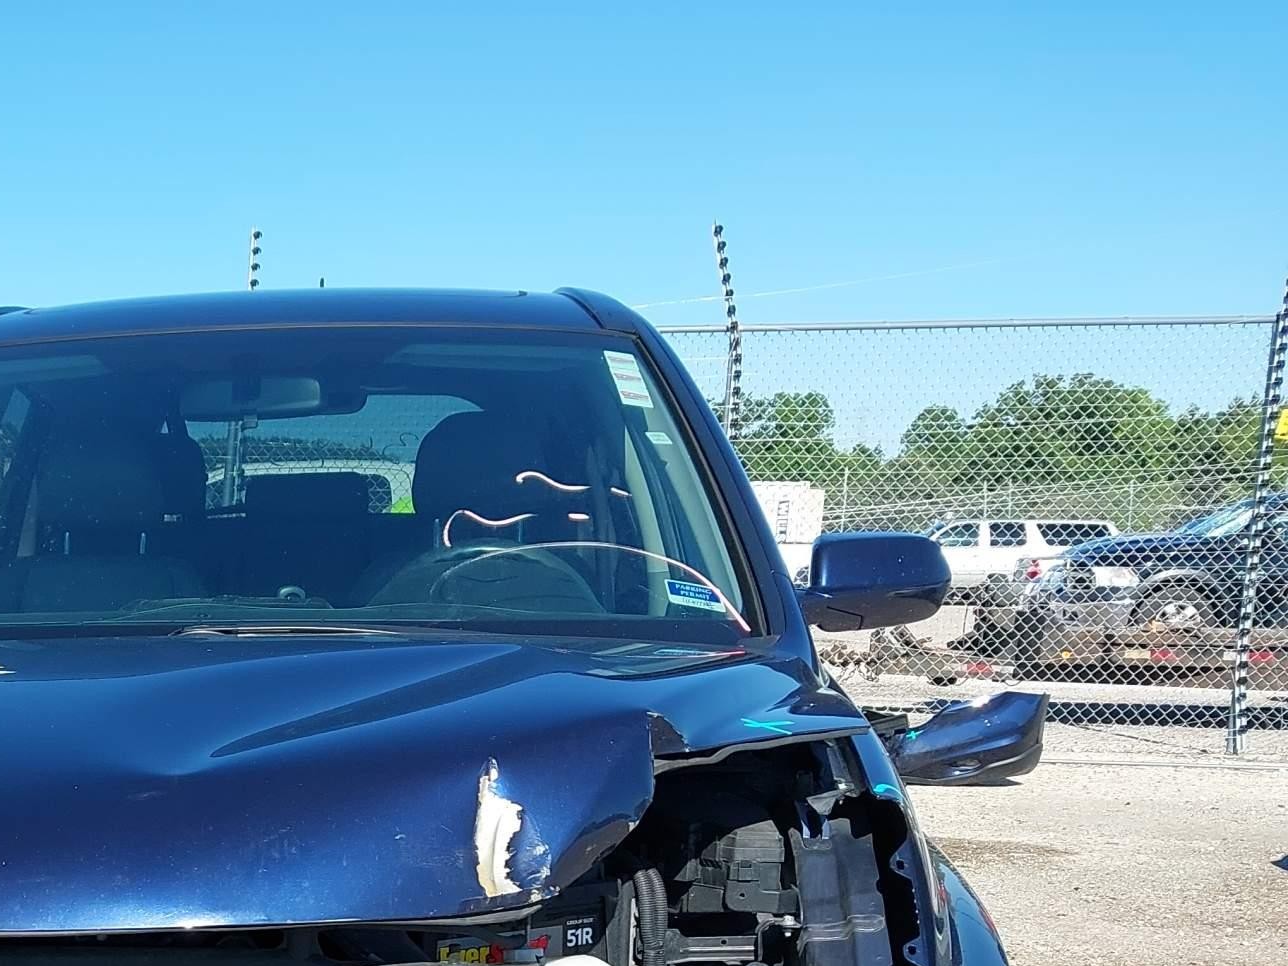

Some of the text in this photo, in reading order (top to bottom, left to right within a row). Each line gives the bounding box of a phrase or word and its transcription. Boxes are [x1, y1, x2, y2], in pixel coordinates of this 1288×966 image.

[675, 583, 712, 595] PARKING
[680, 590, 710, 600] PERMIT
[567, 928, 593, 947] 51R
